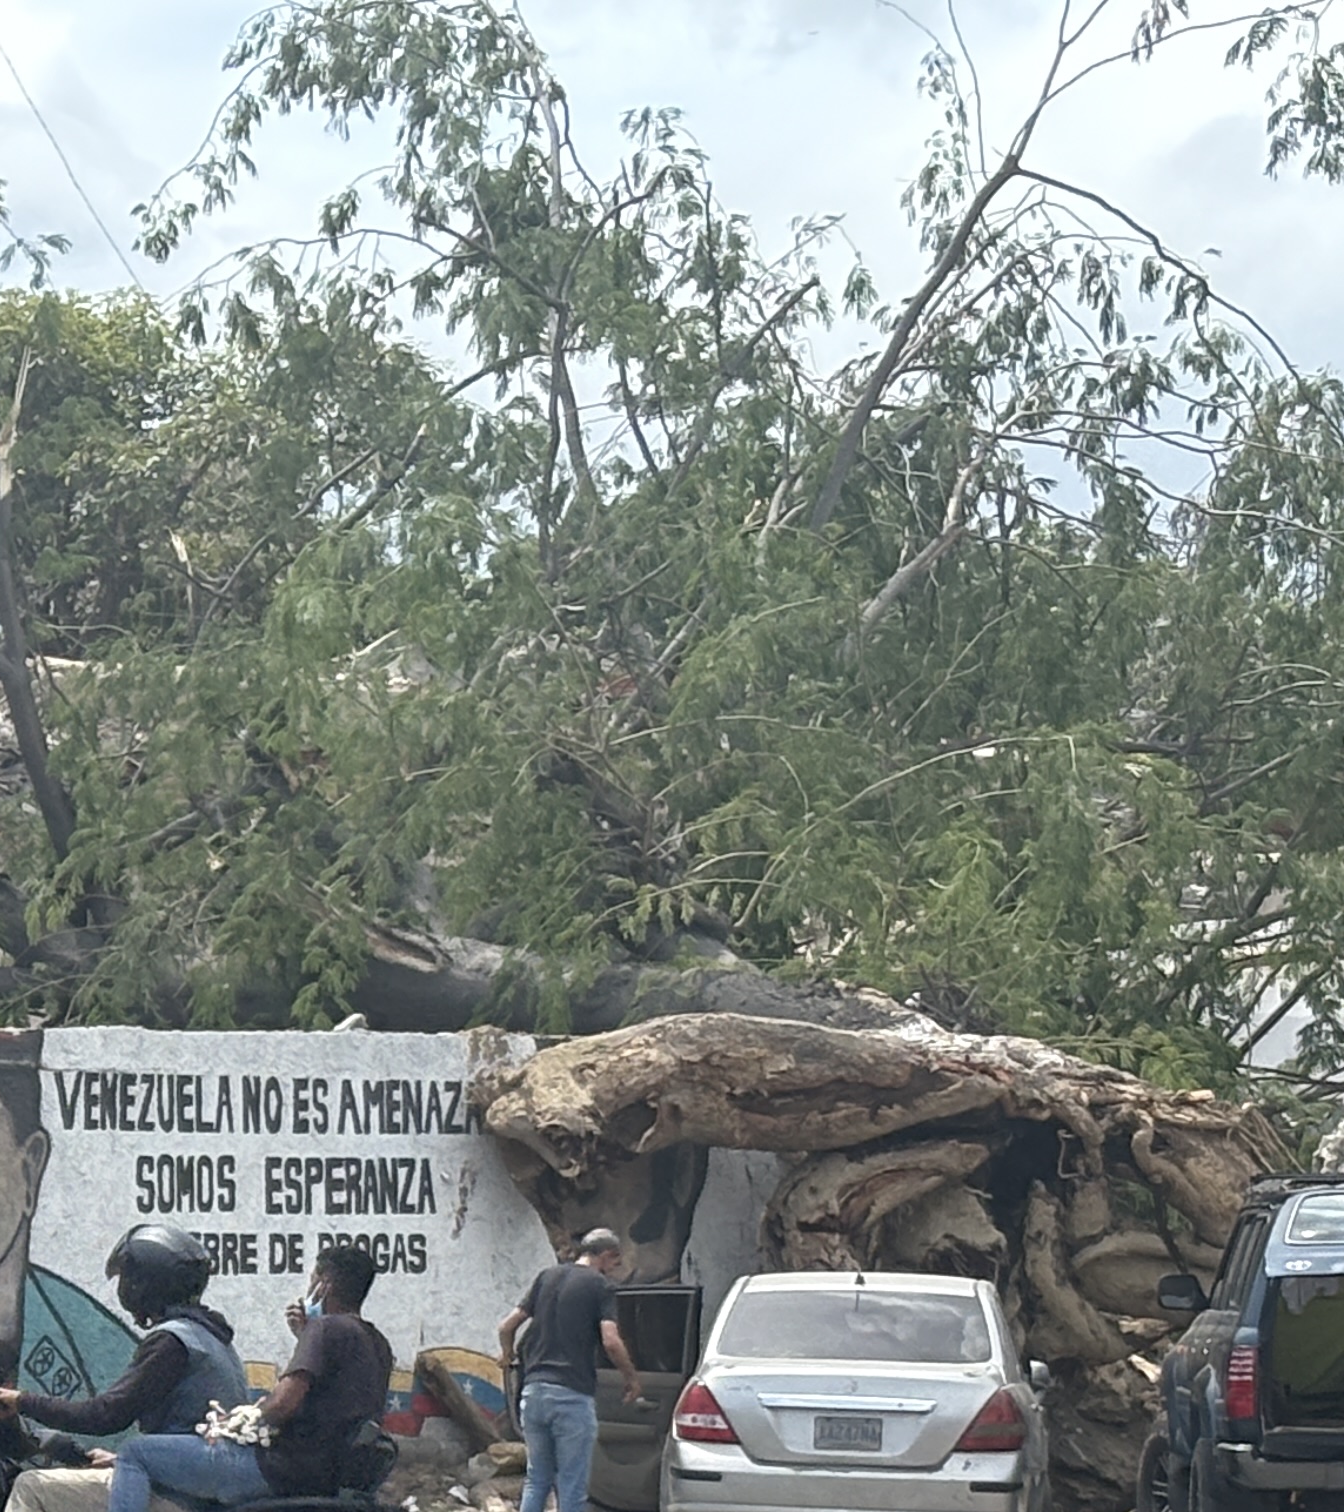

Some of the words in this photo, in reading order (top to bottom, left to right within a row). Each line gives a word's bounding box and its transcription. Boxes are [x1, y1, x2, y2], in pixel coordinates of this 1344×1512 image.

[54, 1071, 234, 1134] VENEZUELA
[241, 1075, 283, 1135] NO
[292, 1077, 329, 1135] ES
[136, 1154, 236, 1214] SOMOS
[265, 1156, 437, 1216] ESPERANZA
[189, 1232, 258, 1276] BRE
[269, 1233, 304, 1274] DE
